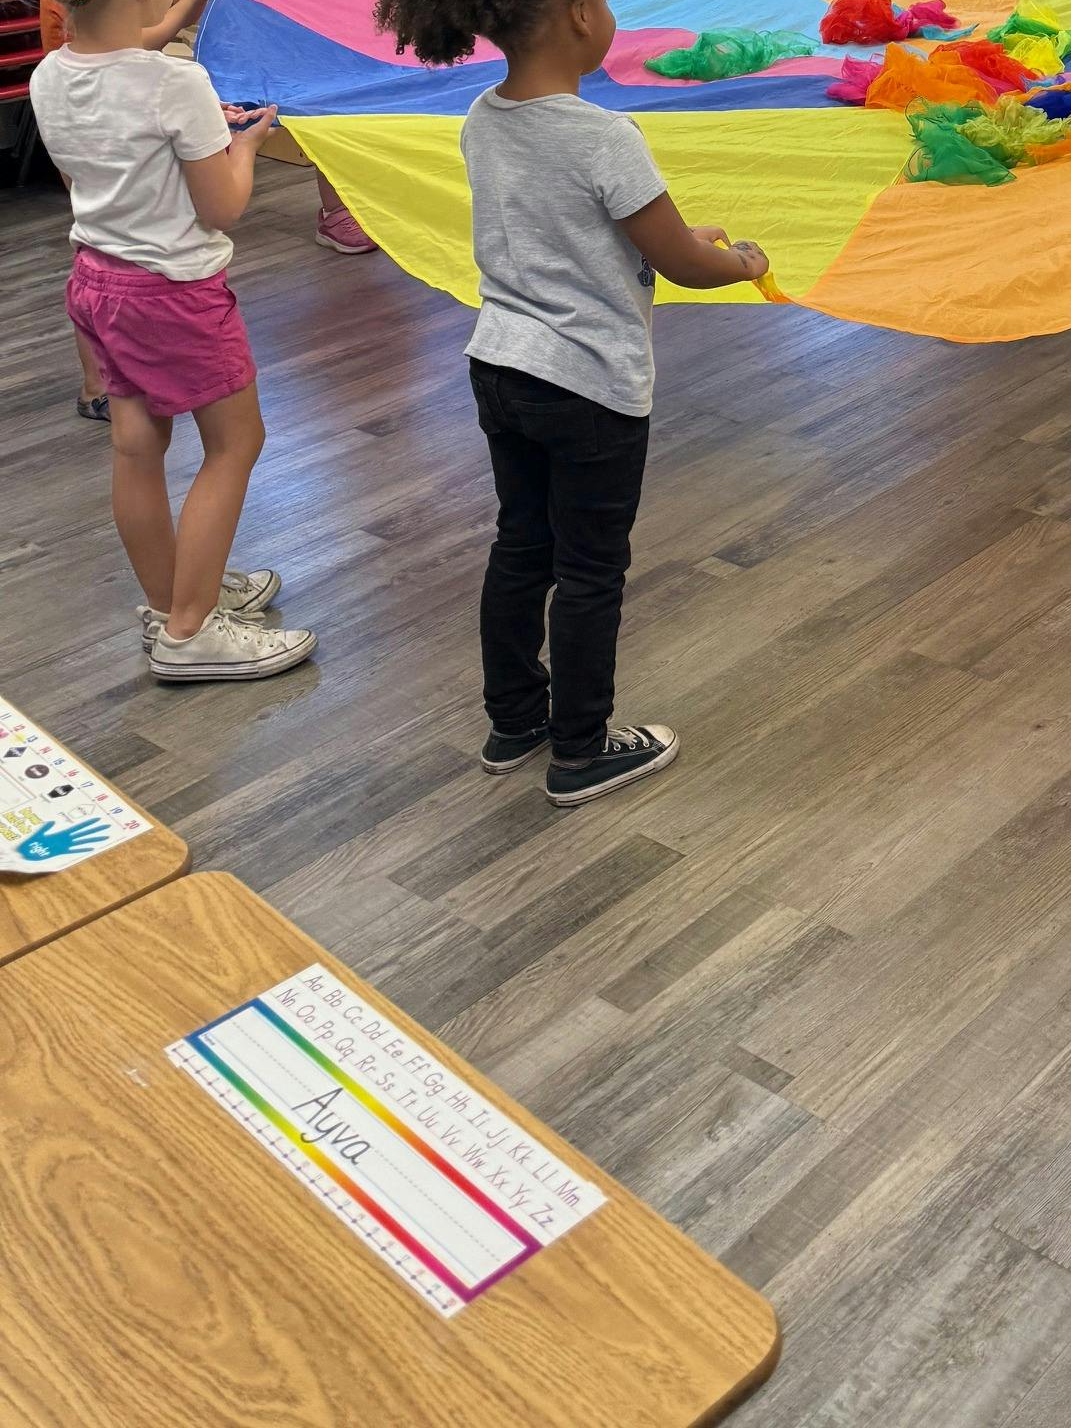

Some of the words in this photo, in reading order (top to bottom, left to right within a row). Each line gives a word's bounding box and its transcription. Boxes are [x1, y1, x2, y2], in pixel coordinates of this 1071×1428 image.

[29, 841, 50, 857] right
[111, 807, 123, 815] 19
[125, 820, 139, 830] 20
[276, 988, 299, 1007] Nn
[296, 1004, 316, 1024] Oo
[313, 1020, 335, 1041] Pp
[335, 1037, 355, 1063] Qq
[354, 1055, 377, 1073] Rr
[376, 1072, 395, 1092] Ss
[396, 1088, 418, 1108] Tt
[417, 1106, 439, 1129] Uu
[441, 1124, 461, 1146] Vv
[462, 1143, 487, 1169] Ww
[486, 1165, 509, 1189] Xx
[508, 1184, 531, 1209] Yy
[529, 1203, 554, 1228] Zz
[291, 1087, 371, 1166] Ayva
[304, 975, 324, 992] Aa
[323, 989, 346, 1008] Bb
[343, 1006, 363, 1025] Cc
[361, 1021, 389, 1041] Dd
[382, 1039, 404, 1058] Ee
[402, 1056, 431, 1074] Ff
[423, 1072, 447, 1097] Gg
[445, 1091, 472, 1113] Hh
[468, 1109, 490, 1129] Ii
[486, 1128, 510, 1149] Jj
[507, 1142, 534, 1165] Kk
[533, 1162, 560, 1183] Ll
[555, 1180, 581, 1208] Mm
